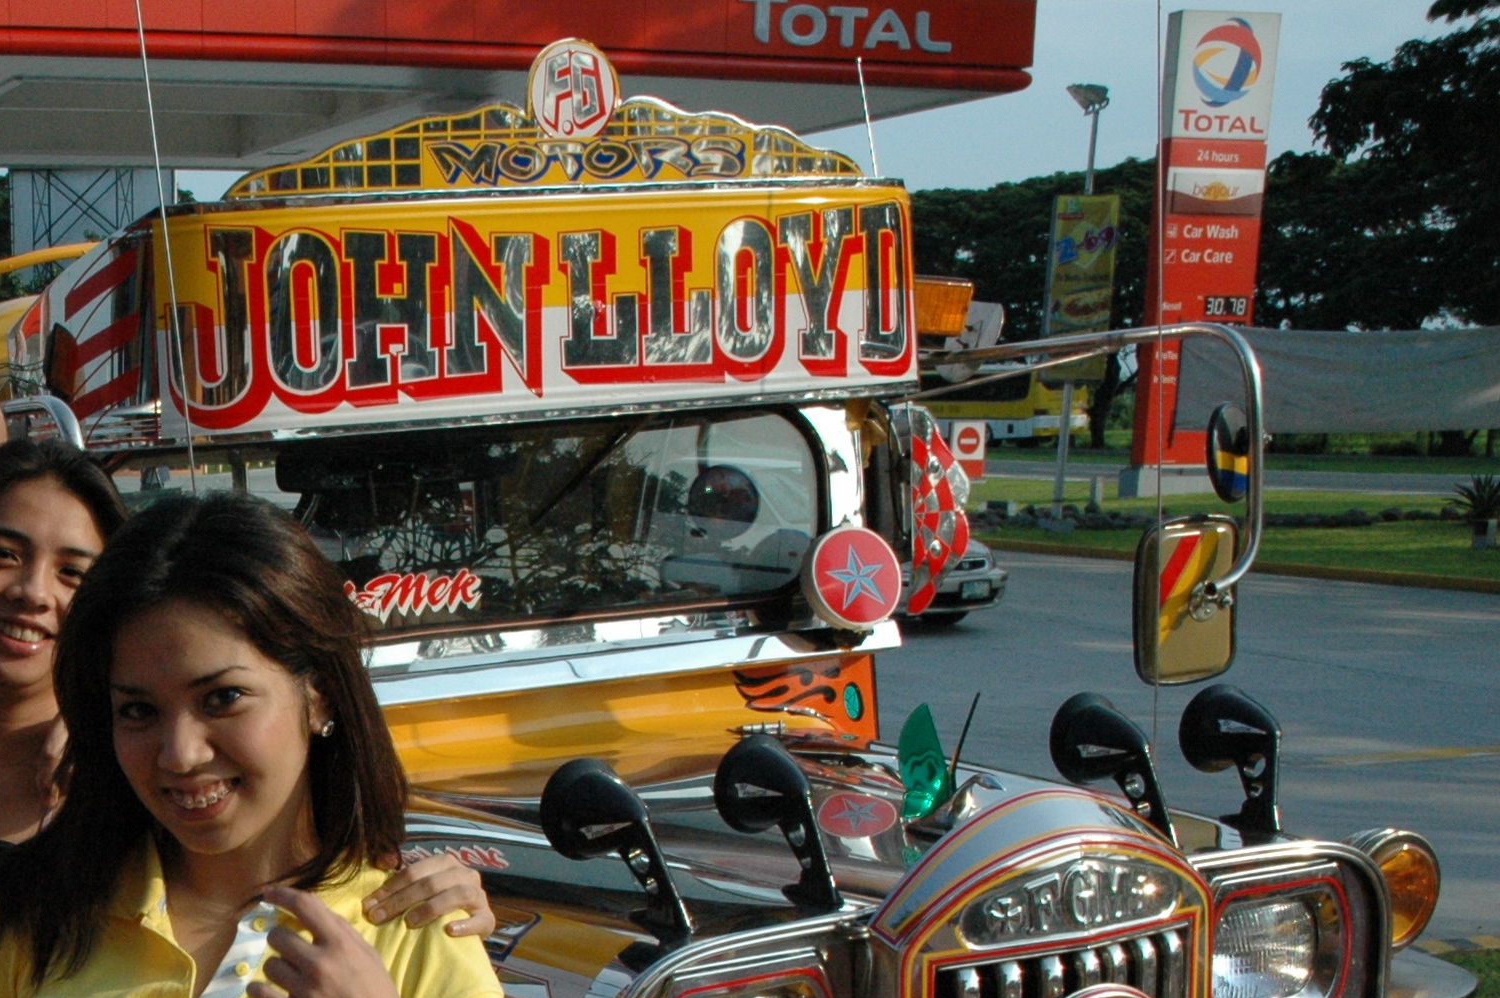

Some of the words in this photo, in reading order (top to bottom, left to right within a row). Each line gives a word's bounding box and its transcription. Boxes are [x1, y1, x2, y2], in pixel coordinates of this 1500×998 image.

[739, 0, 952, 52] TOTAL
[1178, 109, 1264, 134] TOTAL
[427, 136, 746, 186] MOTORS
[1197, 150, 1209, 161] 24
[1211, 150, 1239, 162] hours
[1183, 224, 1203, 239] Car
[1206, 224, 1239, 239] Wash
[1181, 248, 1201, 263] Car
[1203, 248, 1234, 263] Care
[165, 217, 550, 430] JOHN
[557, 199, 912, 383] LLOYD
